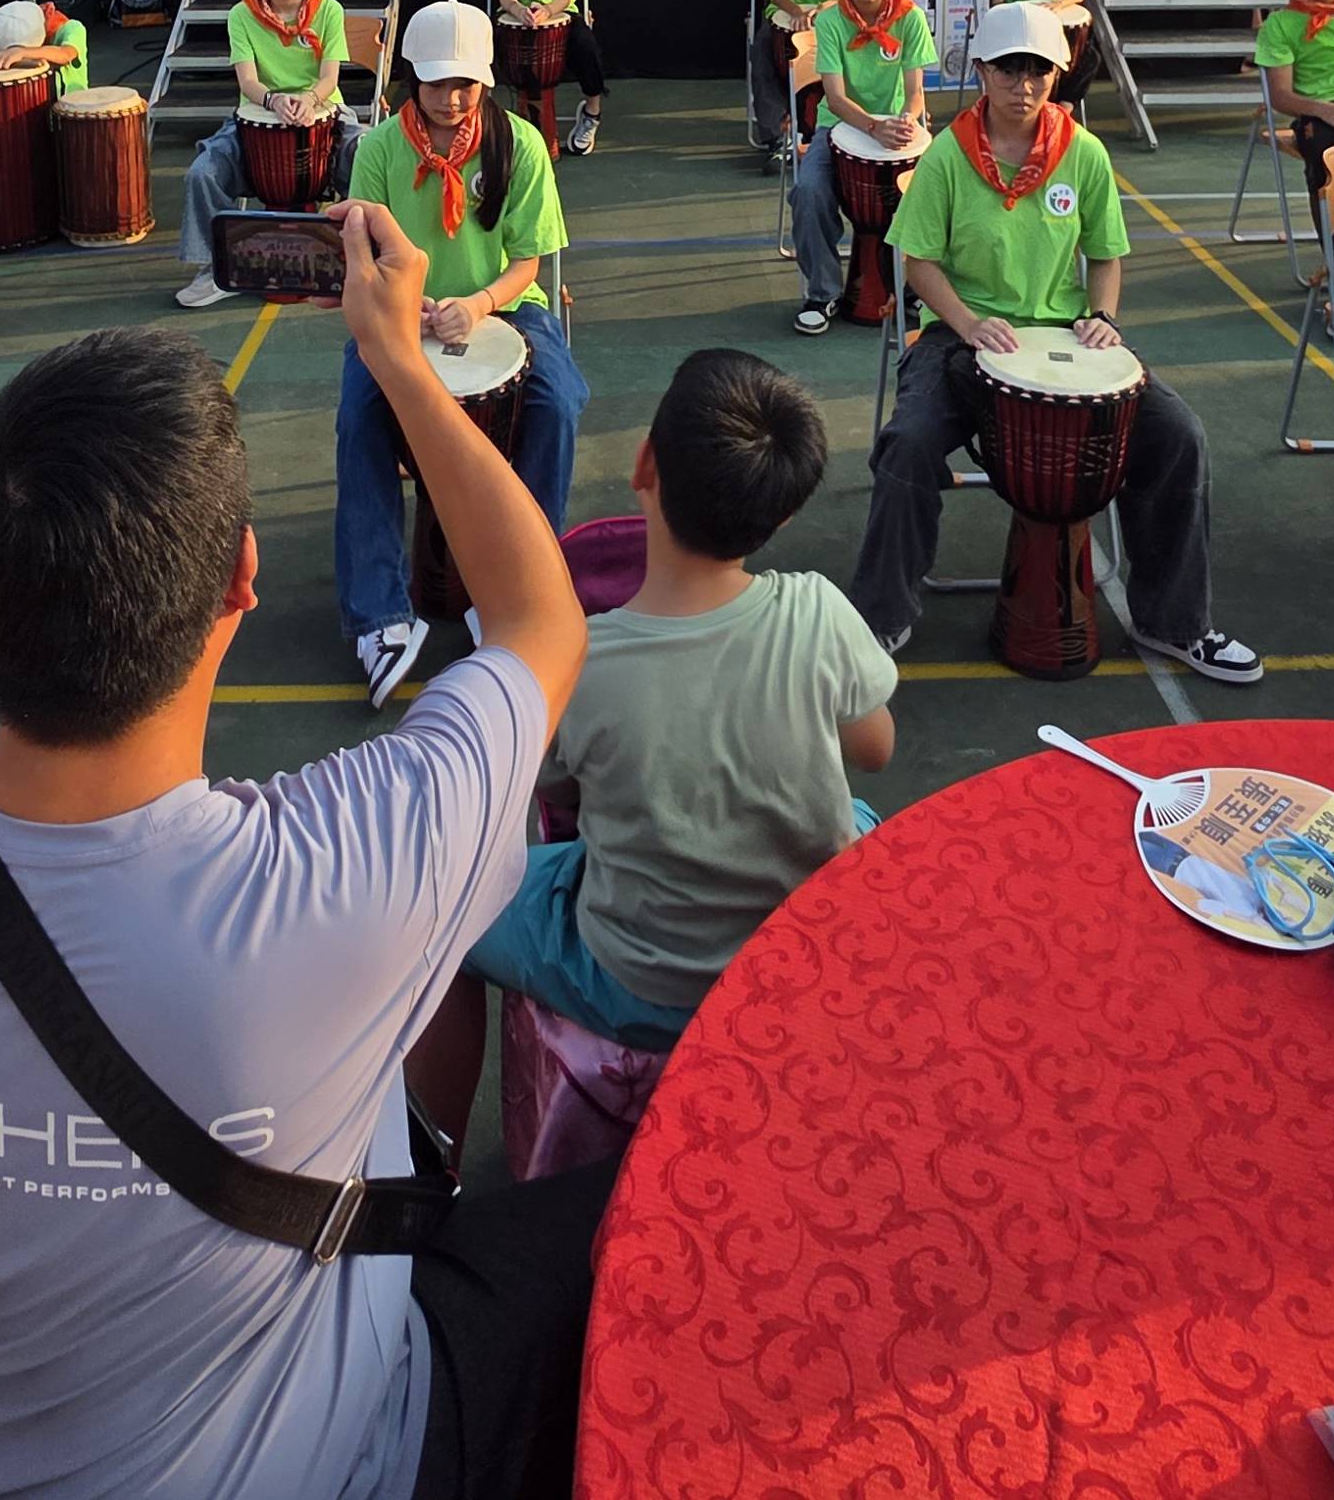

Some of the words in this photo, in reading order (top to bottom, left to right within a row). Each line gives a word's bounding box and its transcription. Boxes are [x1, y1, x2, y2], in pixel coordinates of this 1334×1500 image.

[1194, 775, 1278, 846] 張至順
[24, 1180, 171, 1202] PERFORMS
